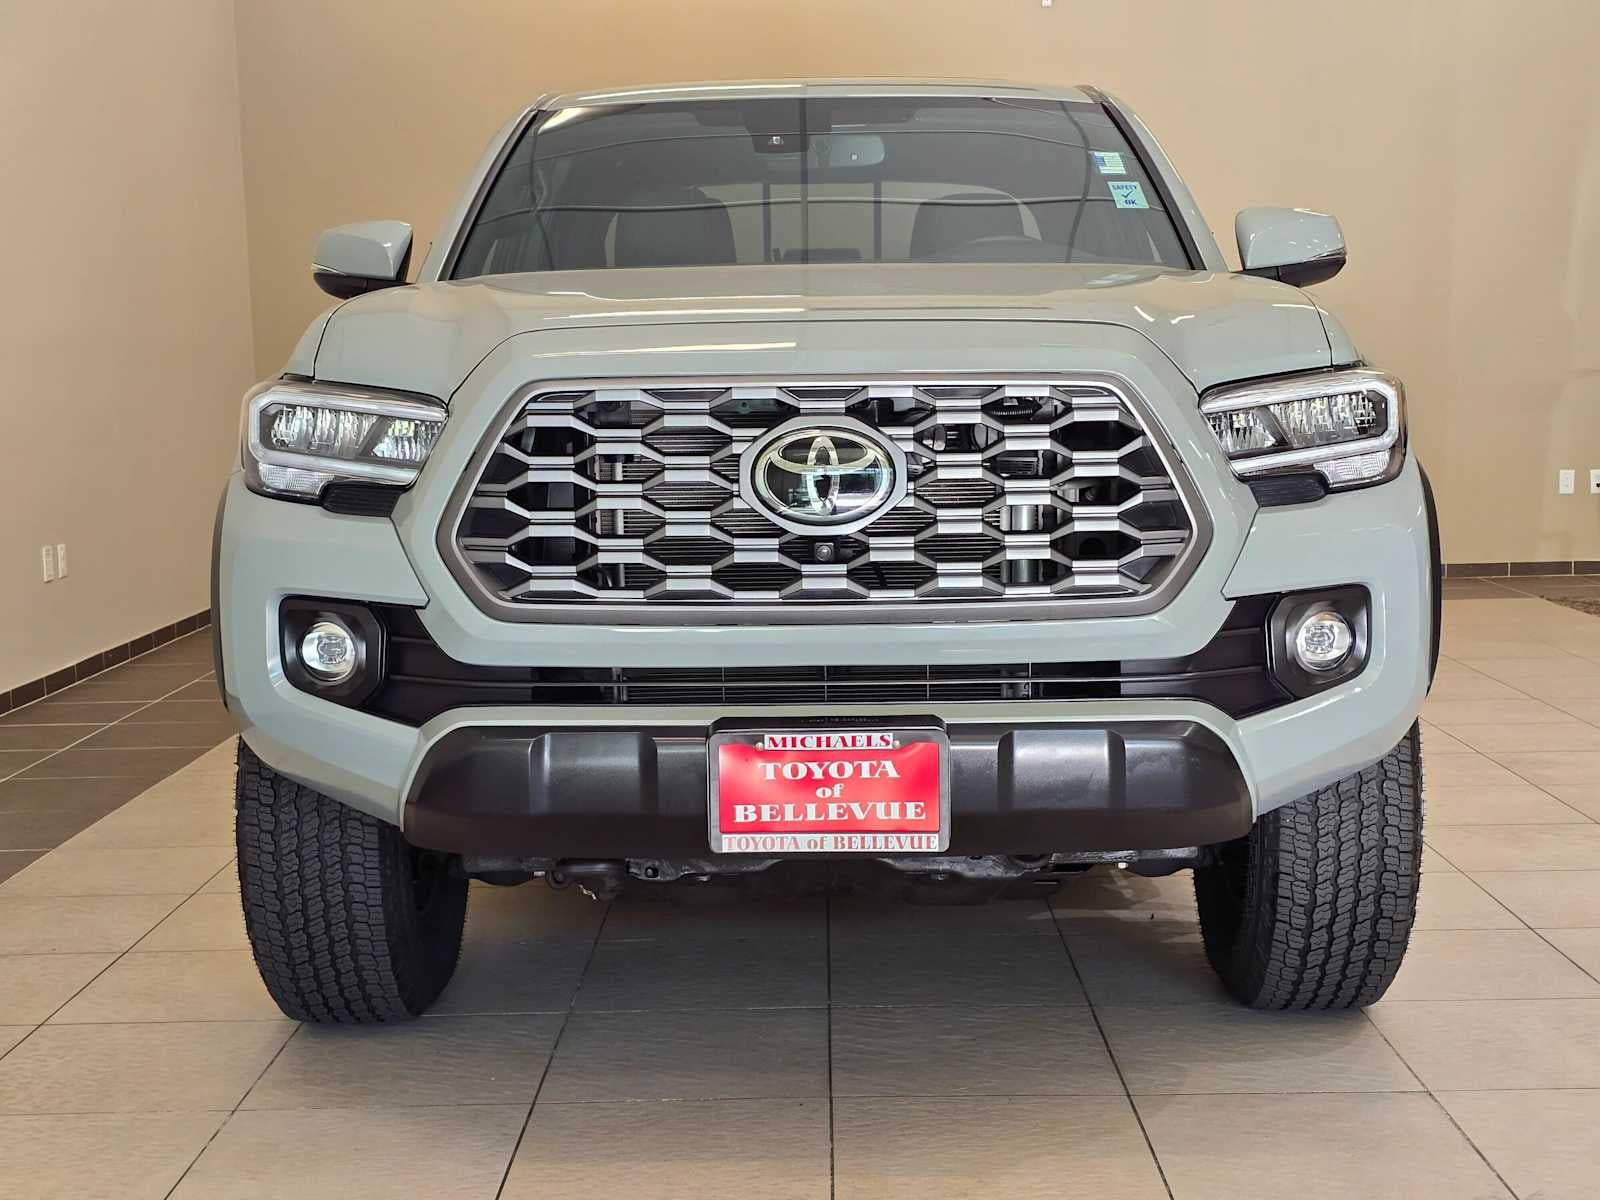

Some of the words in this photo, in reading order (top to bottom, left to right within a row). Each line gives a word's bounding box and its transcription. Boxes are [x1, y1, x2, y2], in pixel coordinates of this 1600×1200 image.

[768, 734, 892, 748] MICHAELS
[758, 760, 900, 780] TOYOTA
[815, 783, 845, 798] of
[732, 801, 926, 823] BELLEVUE
[723, 836, 799, 851] TOYOTA
[806, 836, 827, 850] of
[833, 835, 938, 850] BELLEVUE
